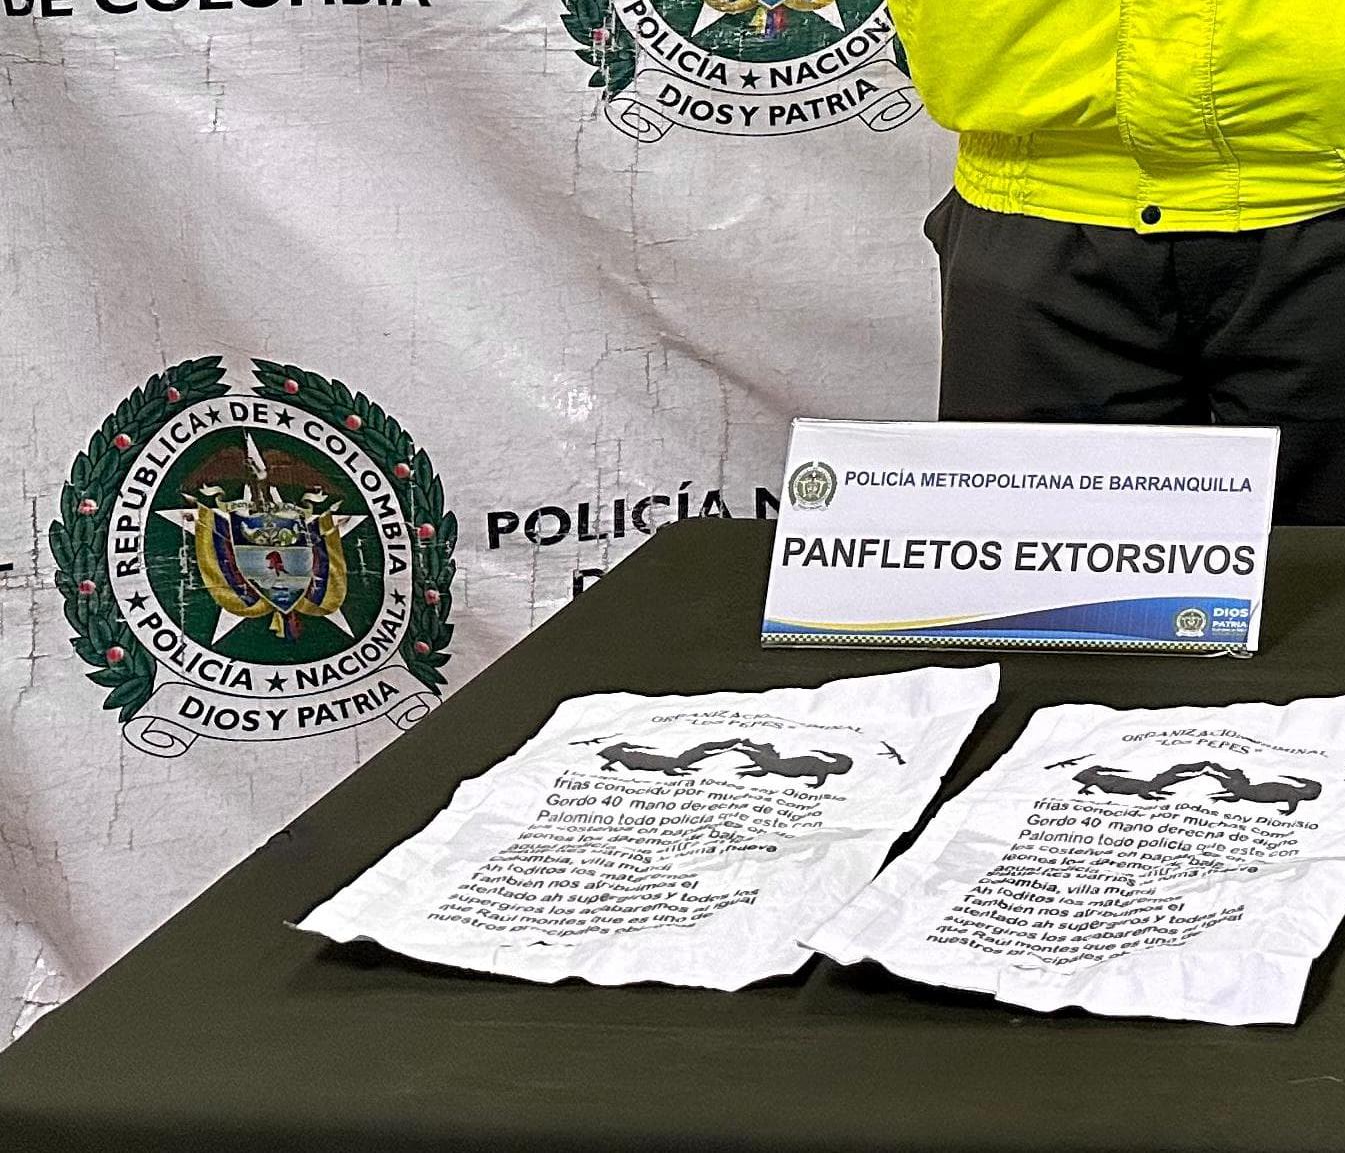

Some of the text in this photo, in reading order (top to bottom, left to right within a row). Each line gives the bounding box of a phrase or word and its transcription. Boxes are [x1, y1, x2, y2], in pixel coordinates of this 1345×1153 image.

[622, 1, 893, 88] POLICÍA NACION
[656, 77, 880, 127] DIOS Y PATRIA
[115, 401, 407, 578] REPÚBLICA DE COLOMBIA
[844, 469, 1252, 493] POLICÍA METROPOLITANA DE BARRANQUILLA
[487, 480, 733, 549] POLICÍA
[781, 537, 1257, 576] PANFLETOS EXTORSIVOS
[1213, 607, 1249, 618] DIOS
[137, 606, 405, 691] POLICÍA NACIONAL
[178, 680, 400, 732] DIOS Y PATRIA
[536, 809, 656, 826] Palomino todo
[546, 793, 597, 807] Gordo
[601, 795, 623, 807] 40
[629, 799, 677, 811] mano
[1018, 828, 1134, 847] Palomino todo
[1026, 813, 1077, 827] Gordo
[1080, 816, 1102, 828] 40
[1108, 821, 1154, 833] mano
[1037, 907, 1069, 918] nos
